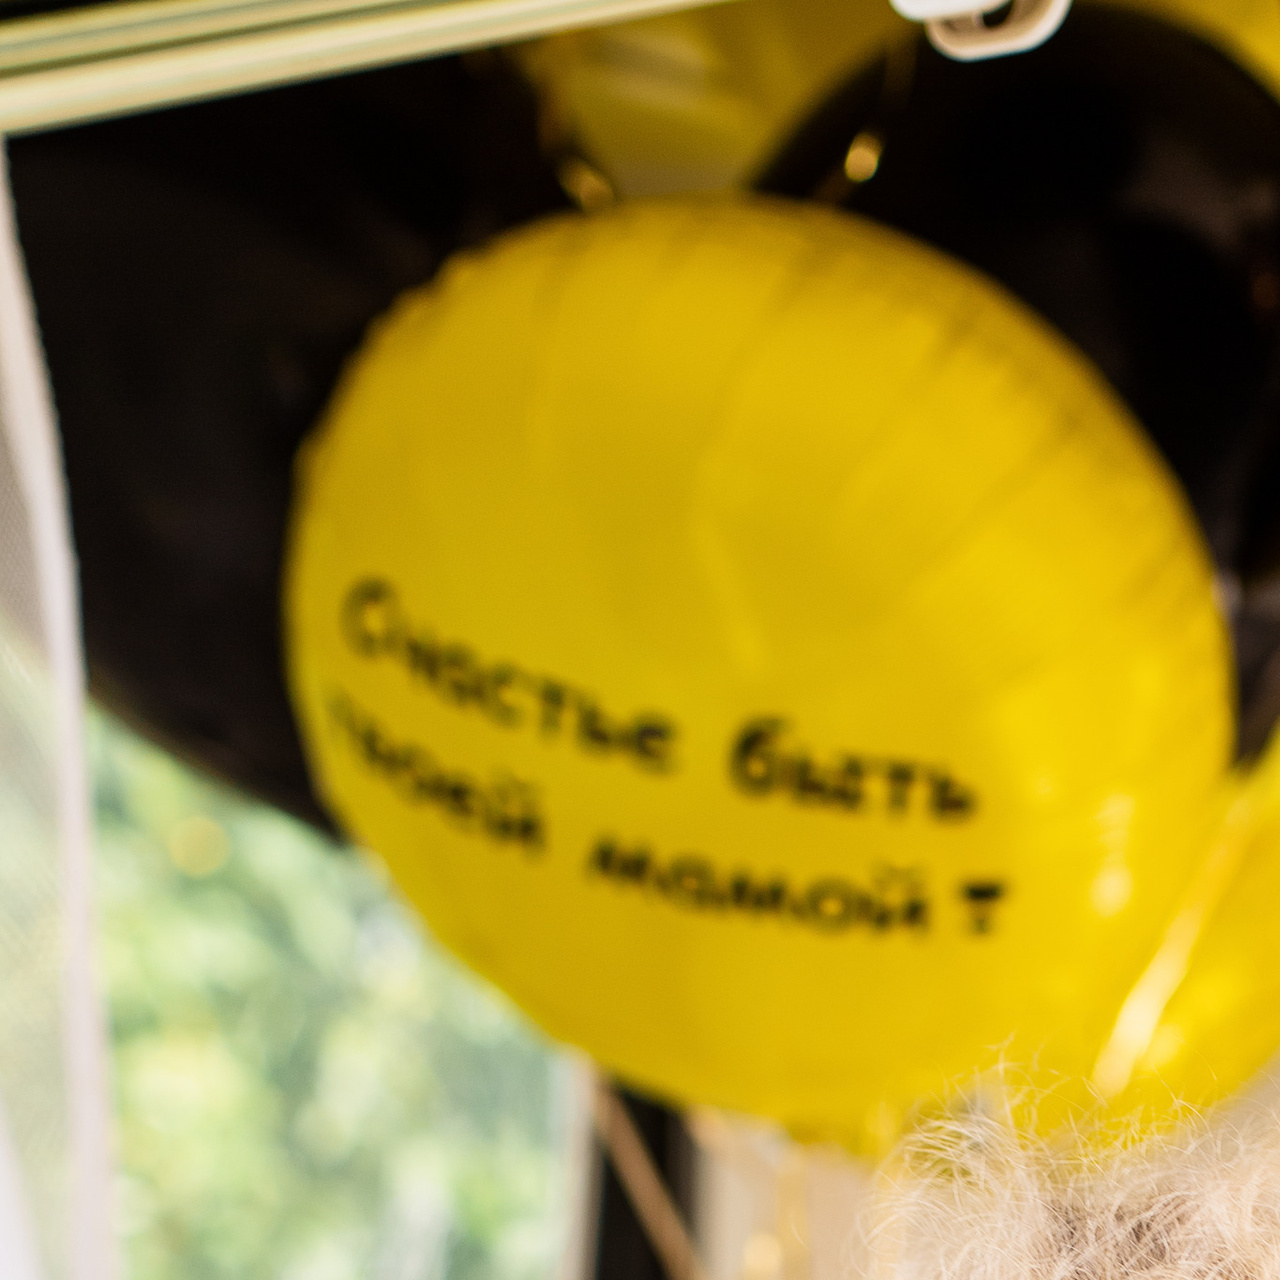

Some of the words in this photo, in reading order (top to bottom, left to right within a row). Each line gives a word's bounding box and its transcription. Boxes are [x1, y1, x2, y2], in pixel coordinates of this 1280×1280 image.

[340, 573, 676, 776] Счастье
[732, 715, 978, 828] быть
[588, 828, 930, 940] мамой
